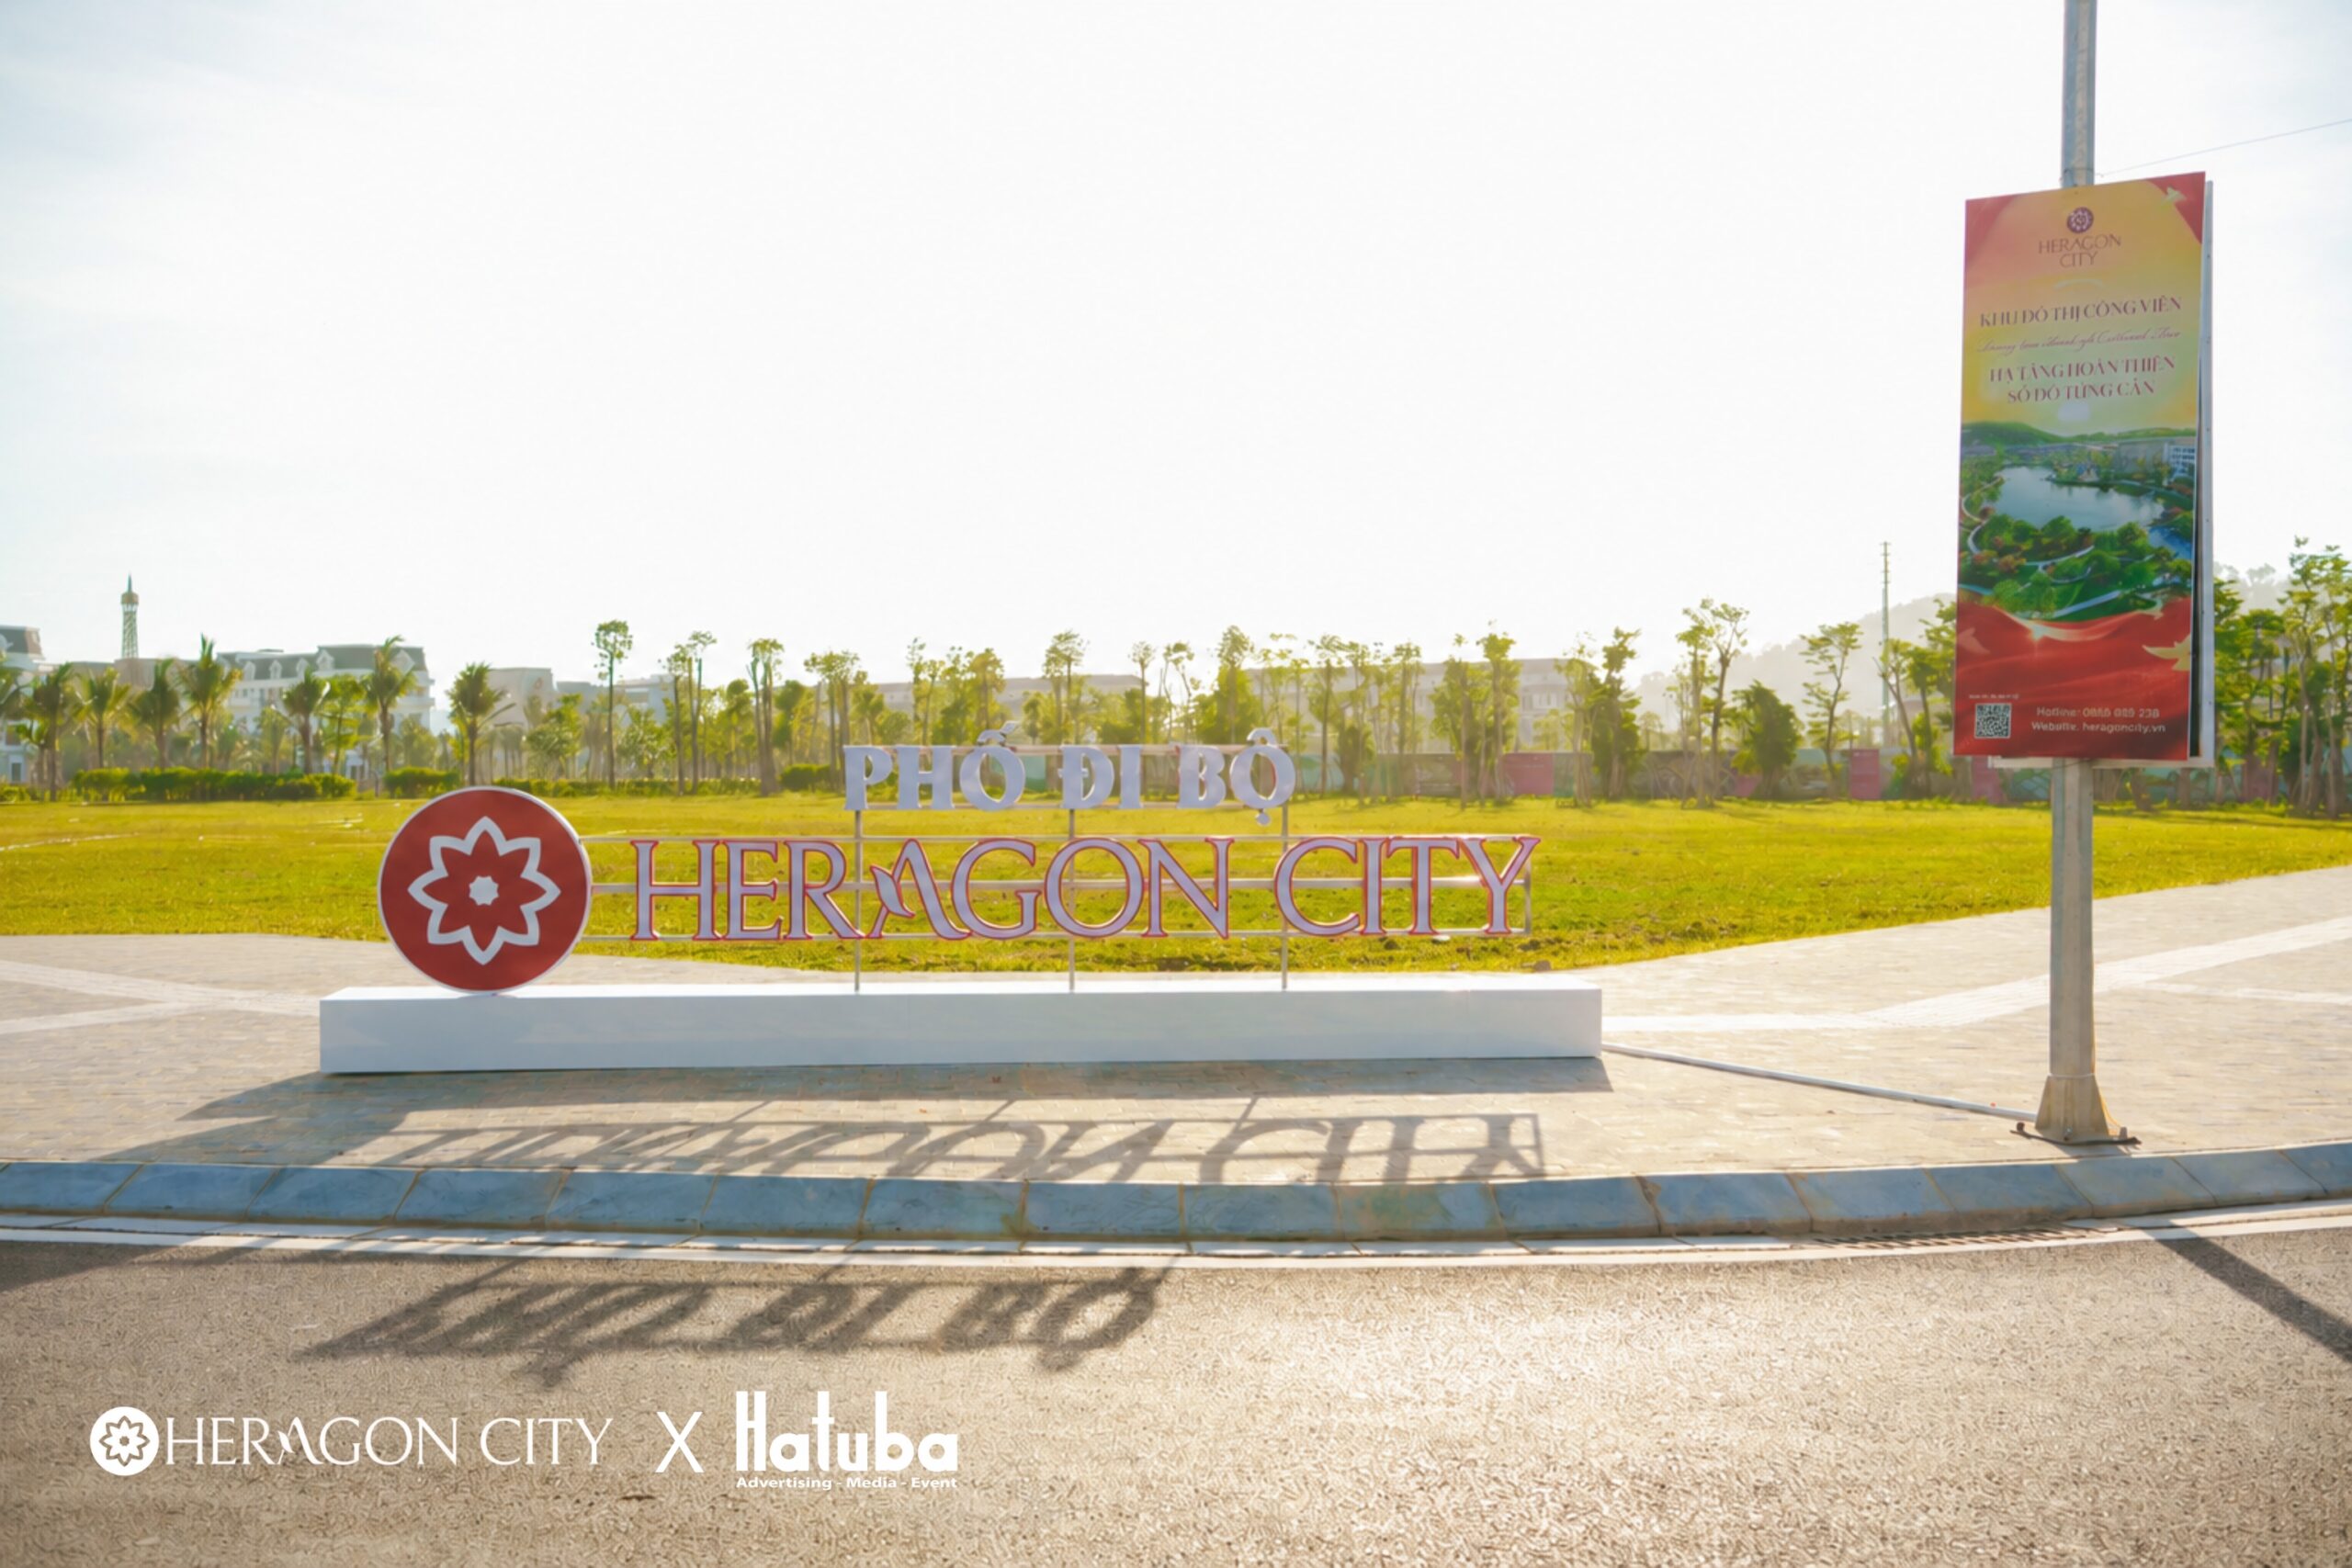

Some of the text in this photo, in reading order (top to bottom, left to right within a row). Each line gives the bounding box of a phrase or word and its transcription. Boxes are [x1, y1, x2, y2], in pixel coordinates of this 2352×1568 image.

[2038, 233, 2121, 254] HERAGON
[2059, 251, 2099, 268] CITY
[1980, 310, 2018, 328] KHU
[2083, 299, 2137, 319] CÔNG
[2139, 294, 2183, 313] VIÊN
[843, 719, 1296, 826] PHỐ ĐI BỘ
[630, 835, 1542, 940] HERAGON CITY
